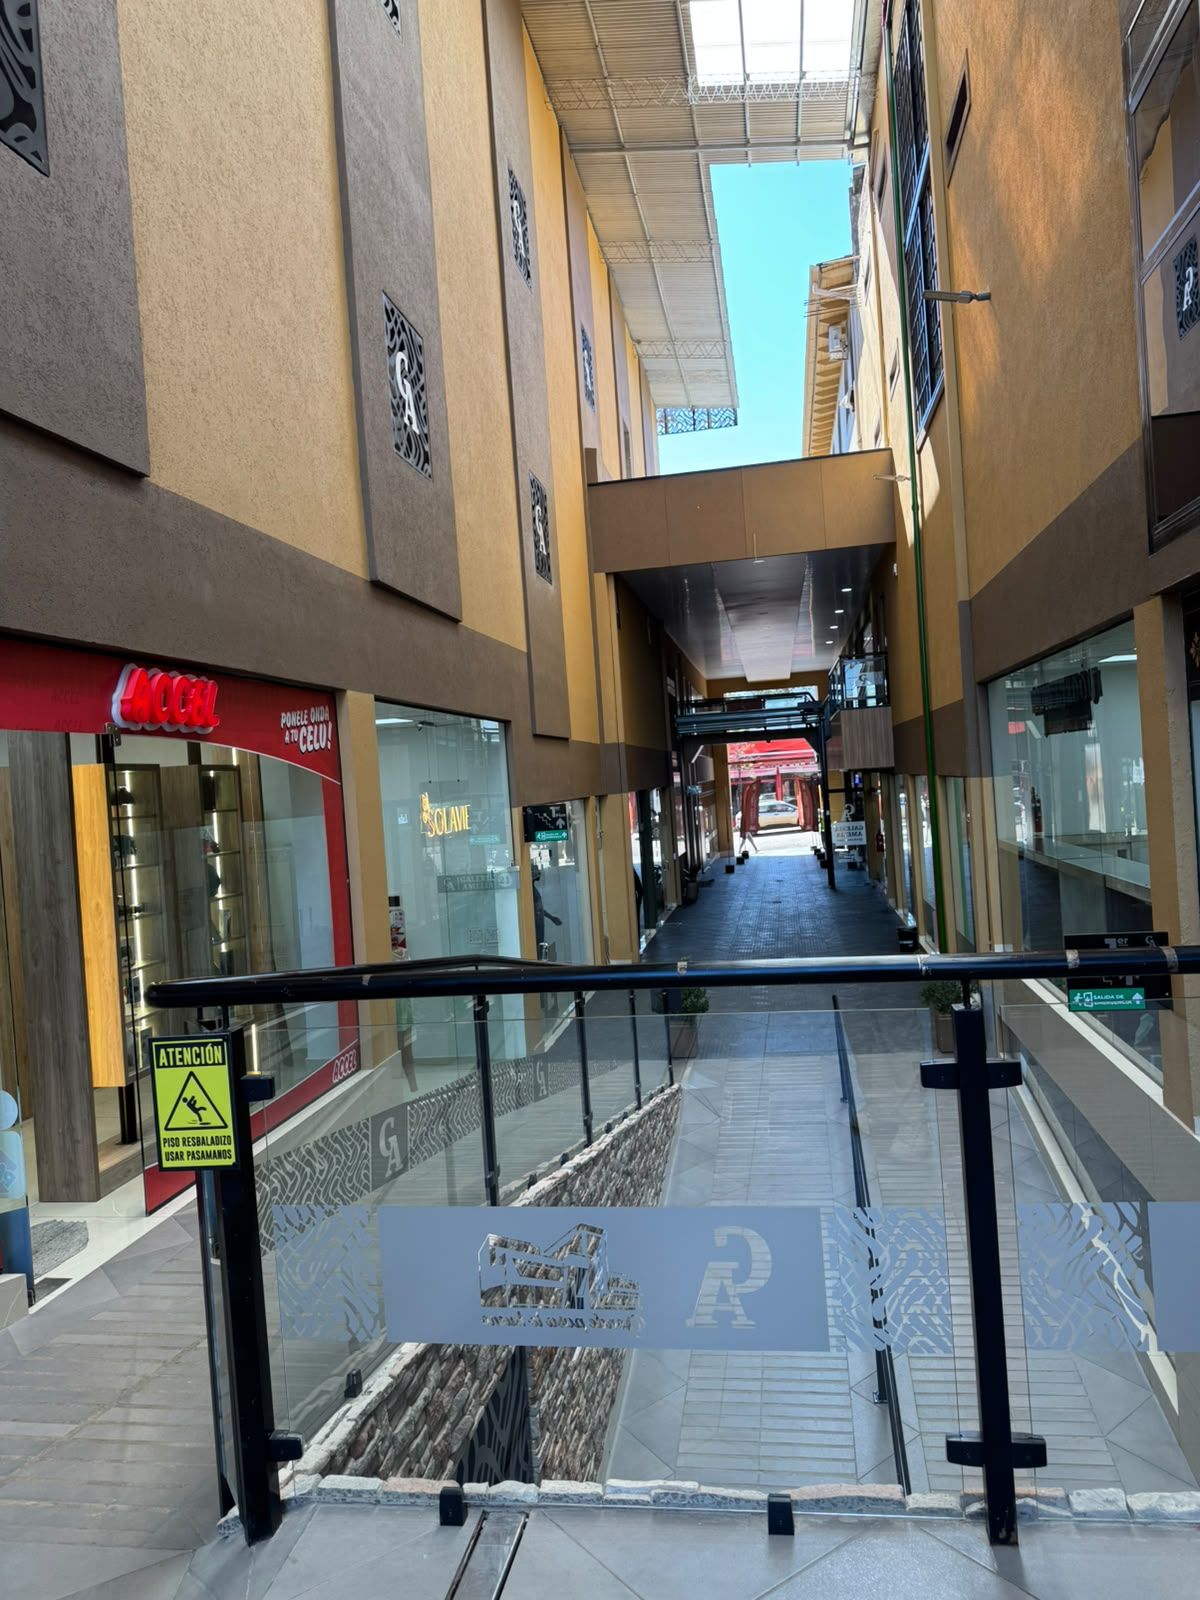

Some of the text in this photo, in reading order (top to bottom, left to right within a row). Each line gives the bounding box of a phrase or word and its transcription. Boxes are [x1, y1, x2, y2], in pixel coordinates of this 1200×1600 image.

[396, 351, 420, 435] GA
[116, 664, 220, 732] ACCEL
[281, 705, 330, 728] PONELE ONDA
[285, 721, 332, 753] A TU CELU!
[160, 1043, 222, 1067] ATENCIÓN
[332, 1049, 357, 1084] ACCEL
[163, 1135, 232, 1148] PISO RESBALADIZO
[165, 1149, 232, 1162] USAR PASAMANOS
[380, 1116, 404, 1178] GA
